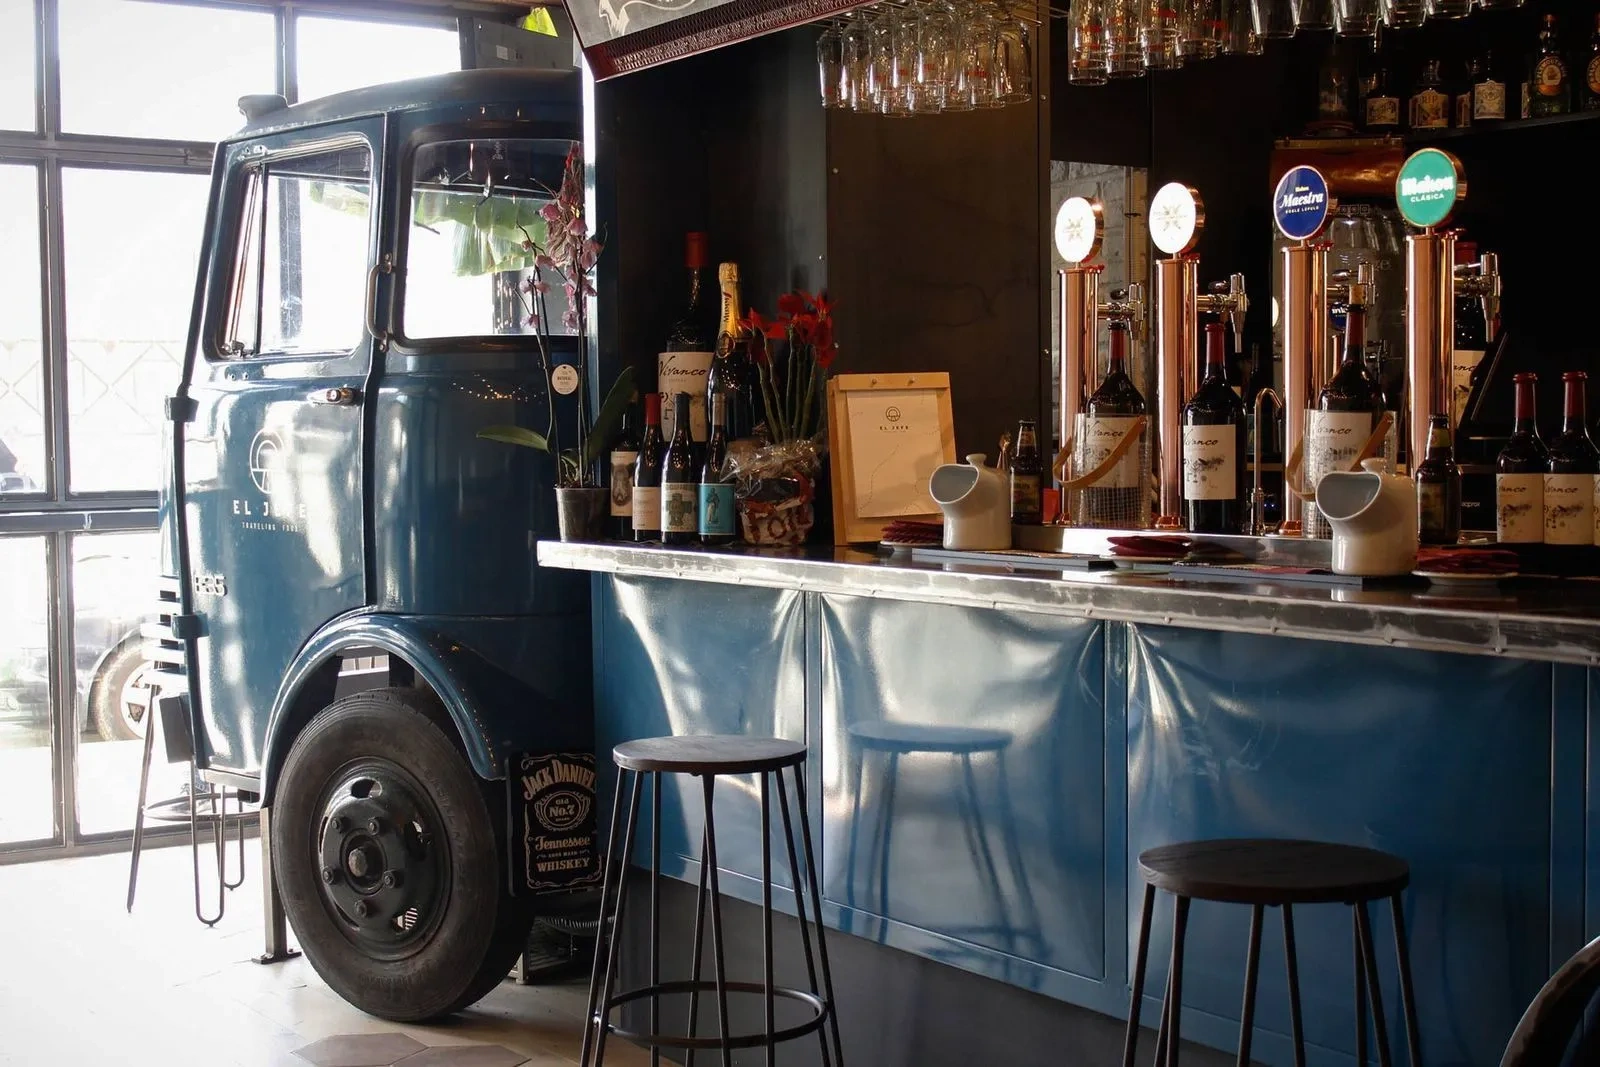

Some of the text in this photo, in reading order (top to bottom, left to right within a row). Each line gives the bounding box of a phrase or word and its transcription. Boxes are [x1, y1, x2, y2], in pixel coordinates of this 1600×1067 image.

[1279, 192, 1324, 209] Maestra
[659, 355, 706, 376] Vivanco
[233, 499, 251, 516] EL
[521, 766, 553, 801] JACK
[535, 835, 591, 852] Tennessee
[536, 857, 591, 873] WHISKEY
